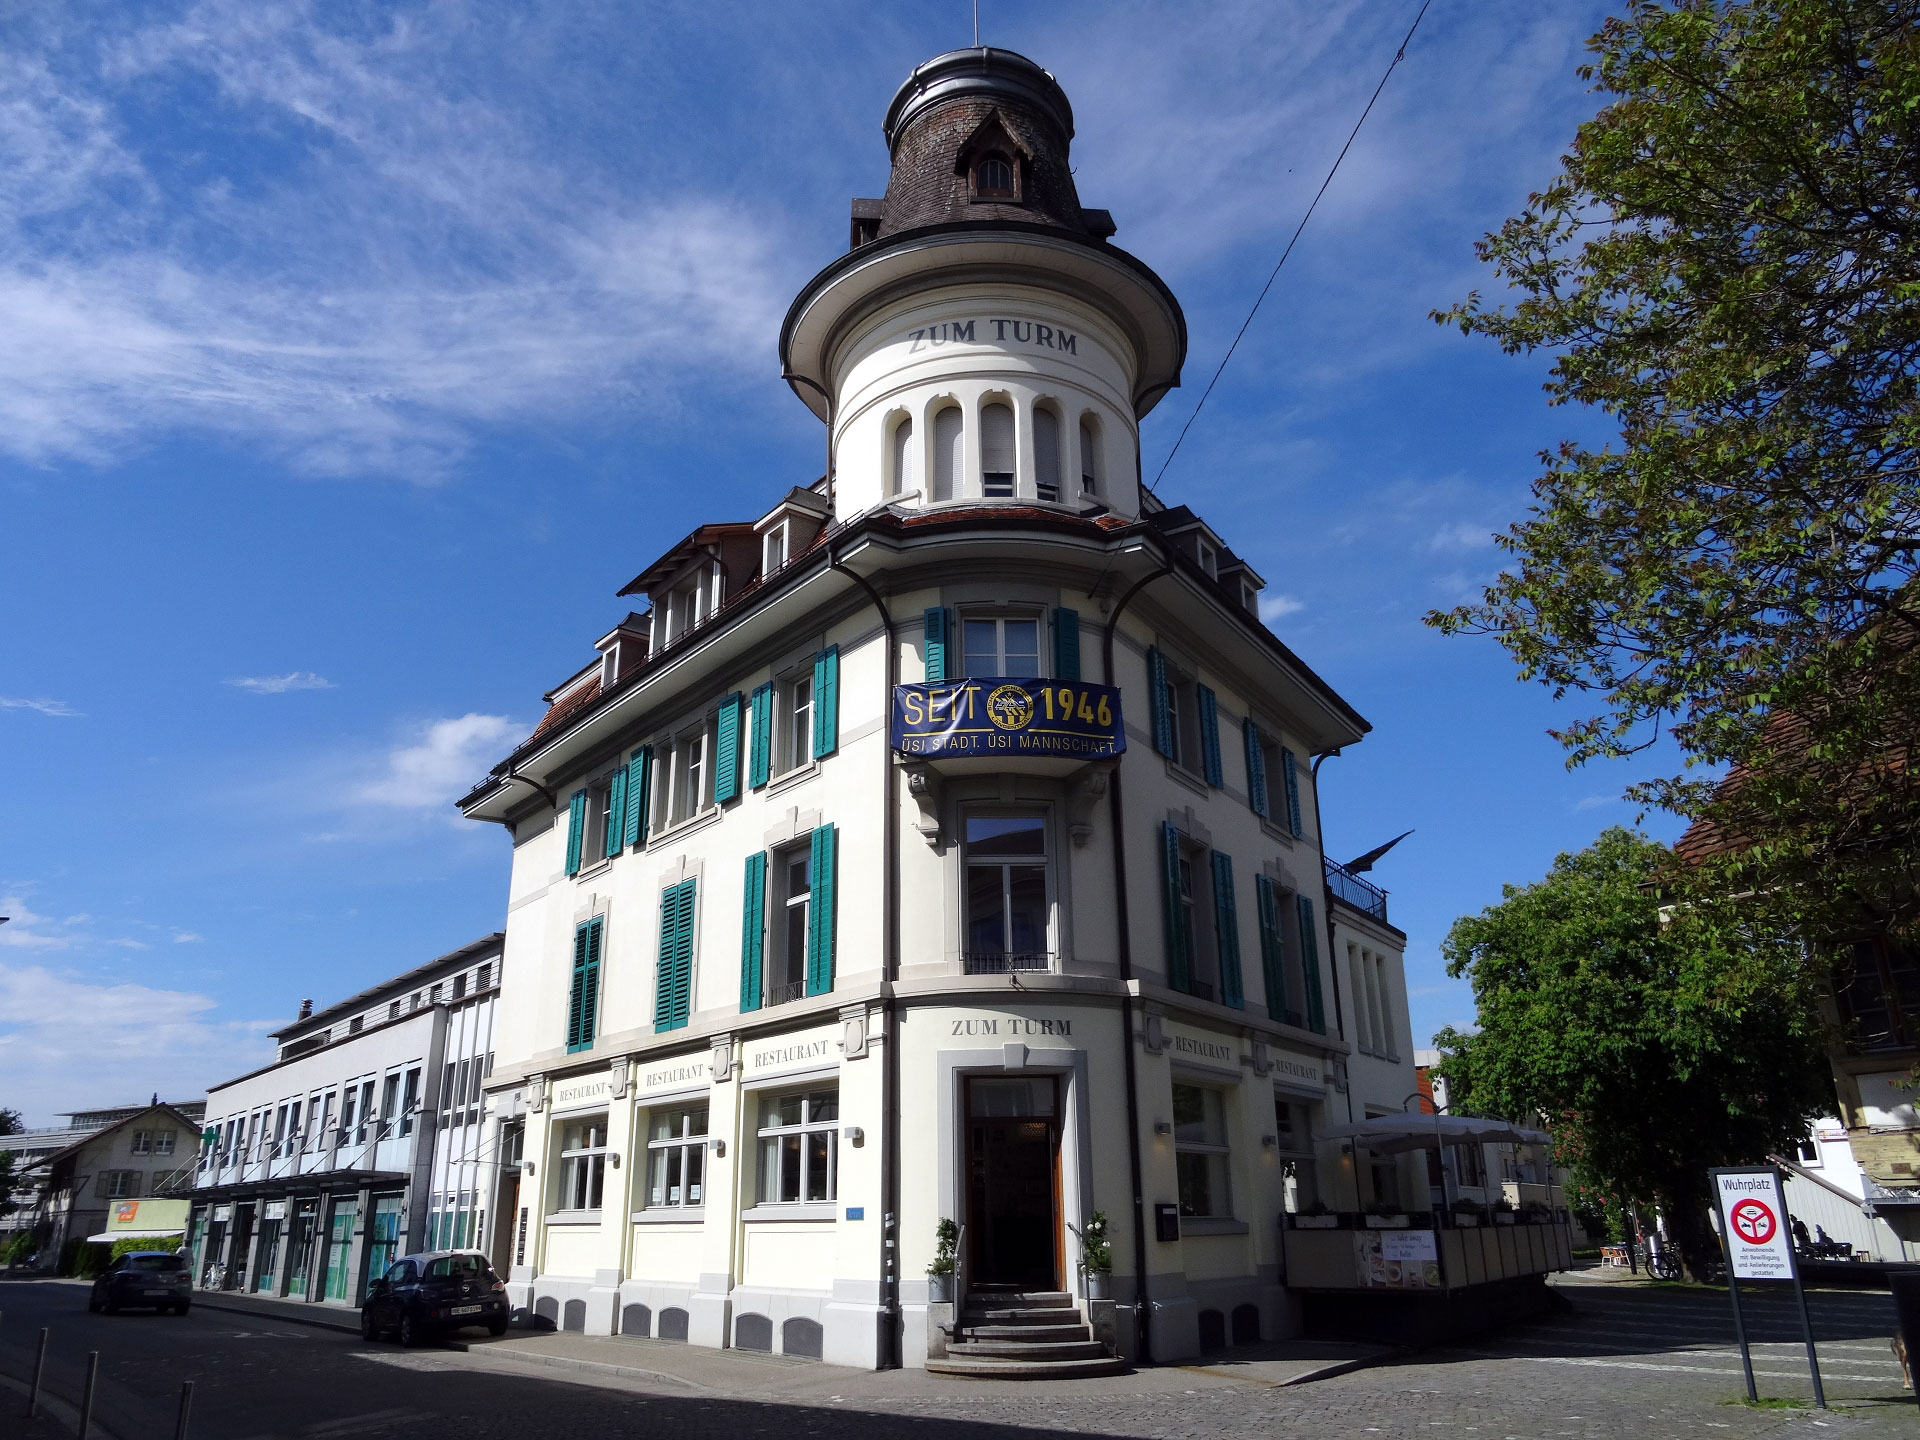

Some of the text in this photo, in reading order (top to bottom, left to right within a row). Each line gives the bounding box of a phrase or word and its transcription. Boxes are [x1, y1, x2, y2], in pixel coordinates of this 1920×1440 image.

[908, 319, 1078, 356] ZUM TURM
[904, 686, 1112, 727] SEIT 1946
[902, 733, 1117, 754] ÜSI STADT. ÜSI MANNSCHAFT.
[952, 1020, 1073, 1036] ZUM TURM
[754, 1040, 829, 1068] RESTAURANT
[1175, 1035, 1231, 1061] RESTAURANT
[646, 1064, 704, 1087] RESTAURANT
[1276, 1059, 1317, 1081] RESTAURANT
[559, 1081, 606, 1102] RESTAURANT
[1722, 1178, 1771, 1193] Wuhrplatz
